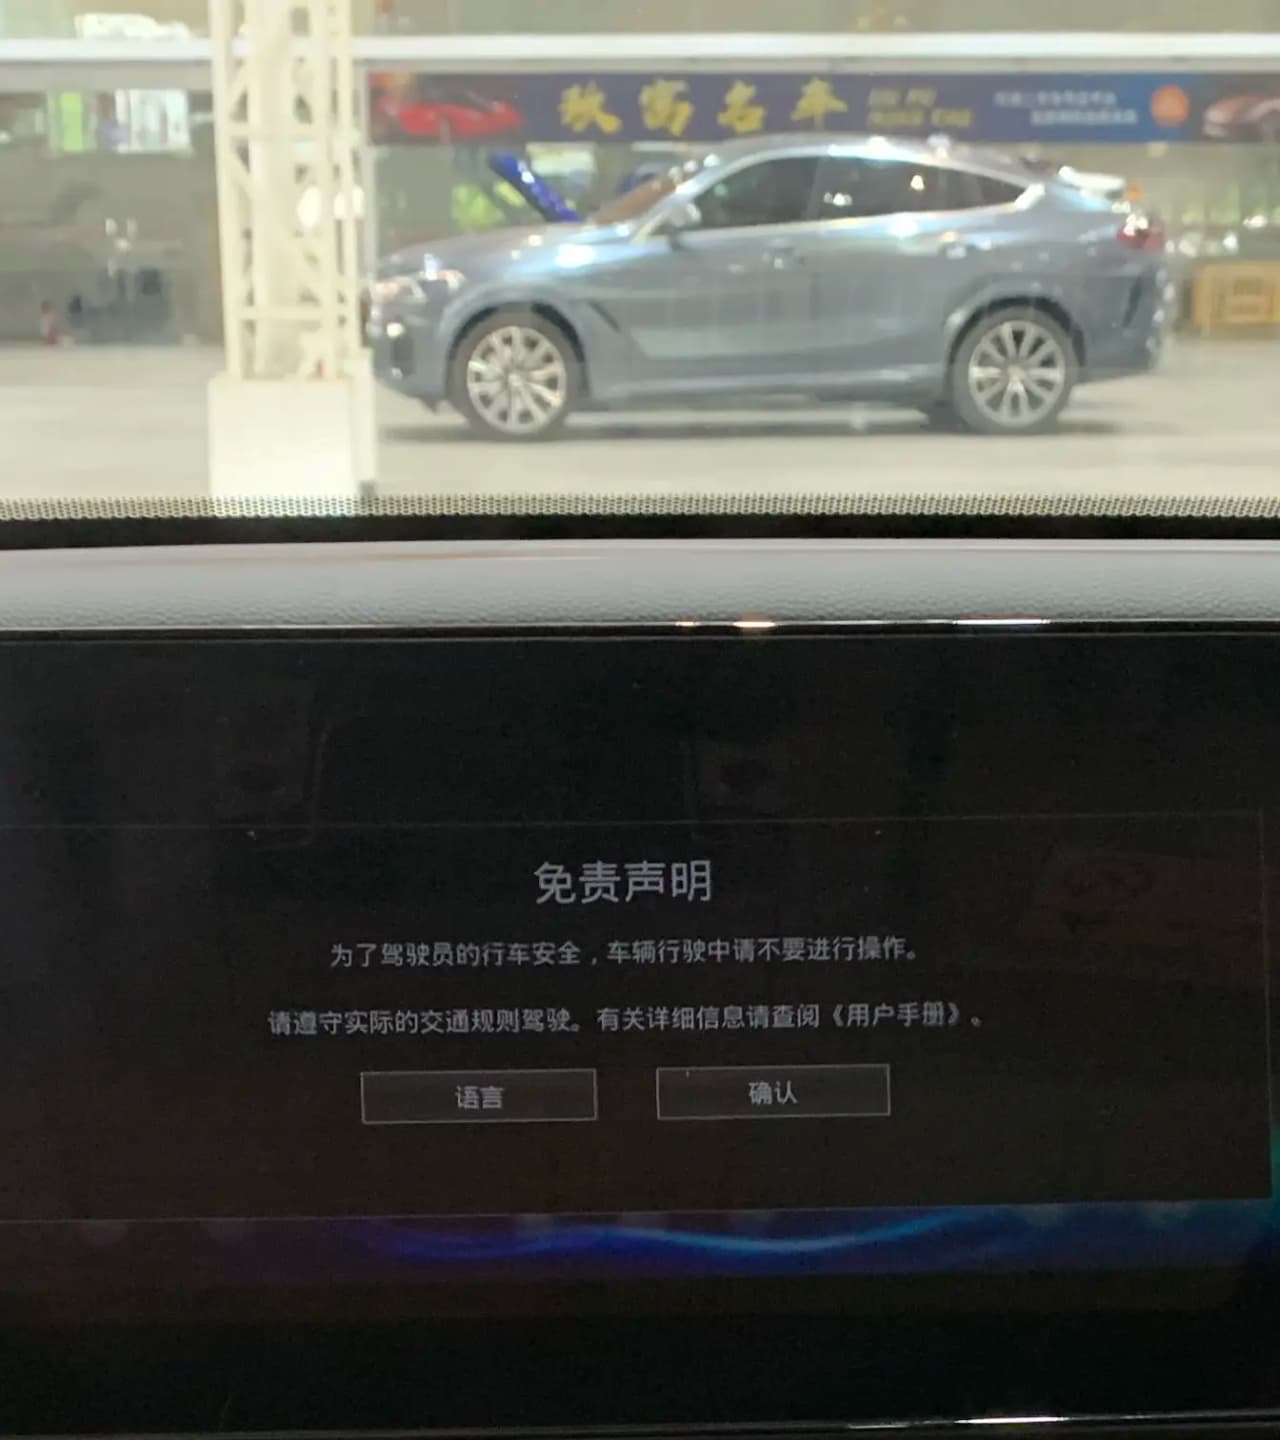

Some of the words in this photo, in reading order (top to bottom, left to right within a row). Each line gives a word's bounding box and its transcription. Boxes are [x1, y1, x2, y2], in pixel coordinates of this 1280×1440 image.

[533, 860, 713, 904] 免责声明
[455, 1085, 505, 1110] 语言
[748, 1080, 799, 1105] 确认
